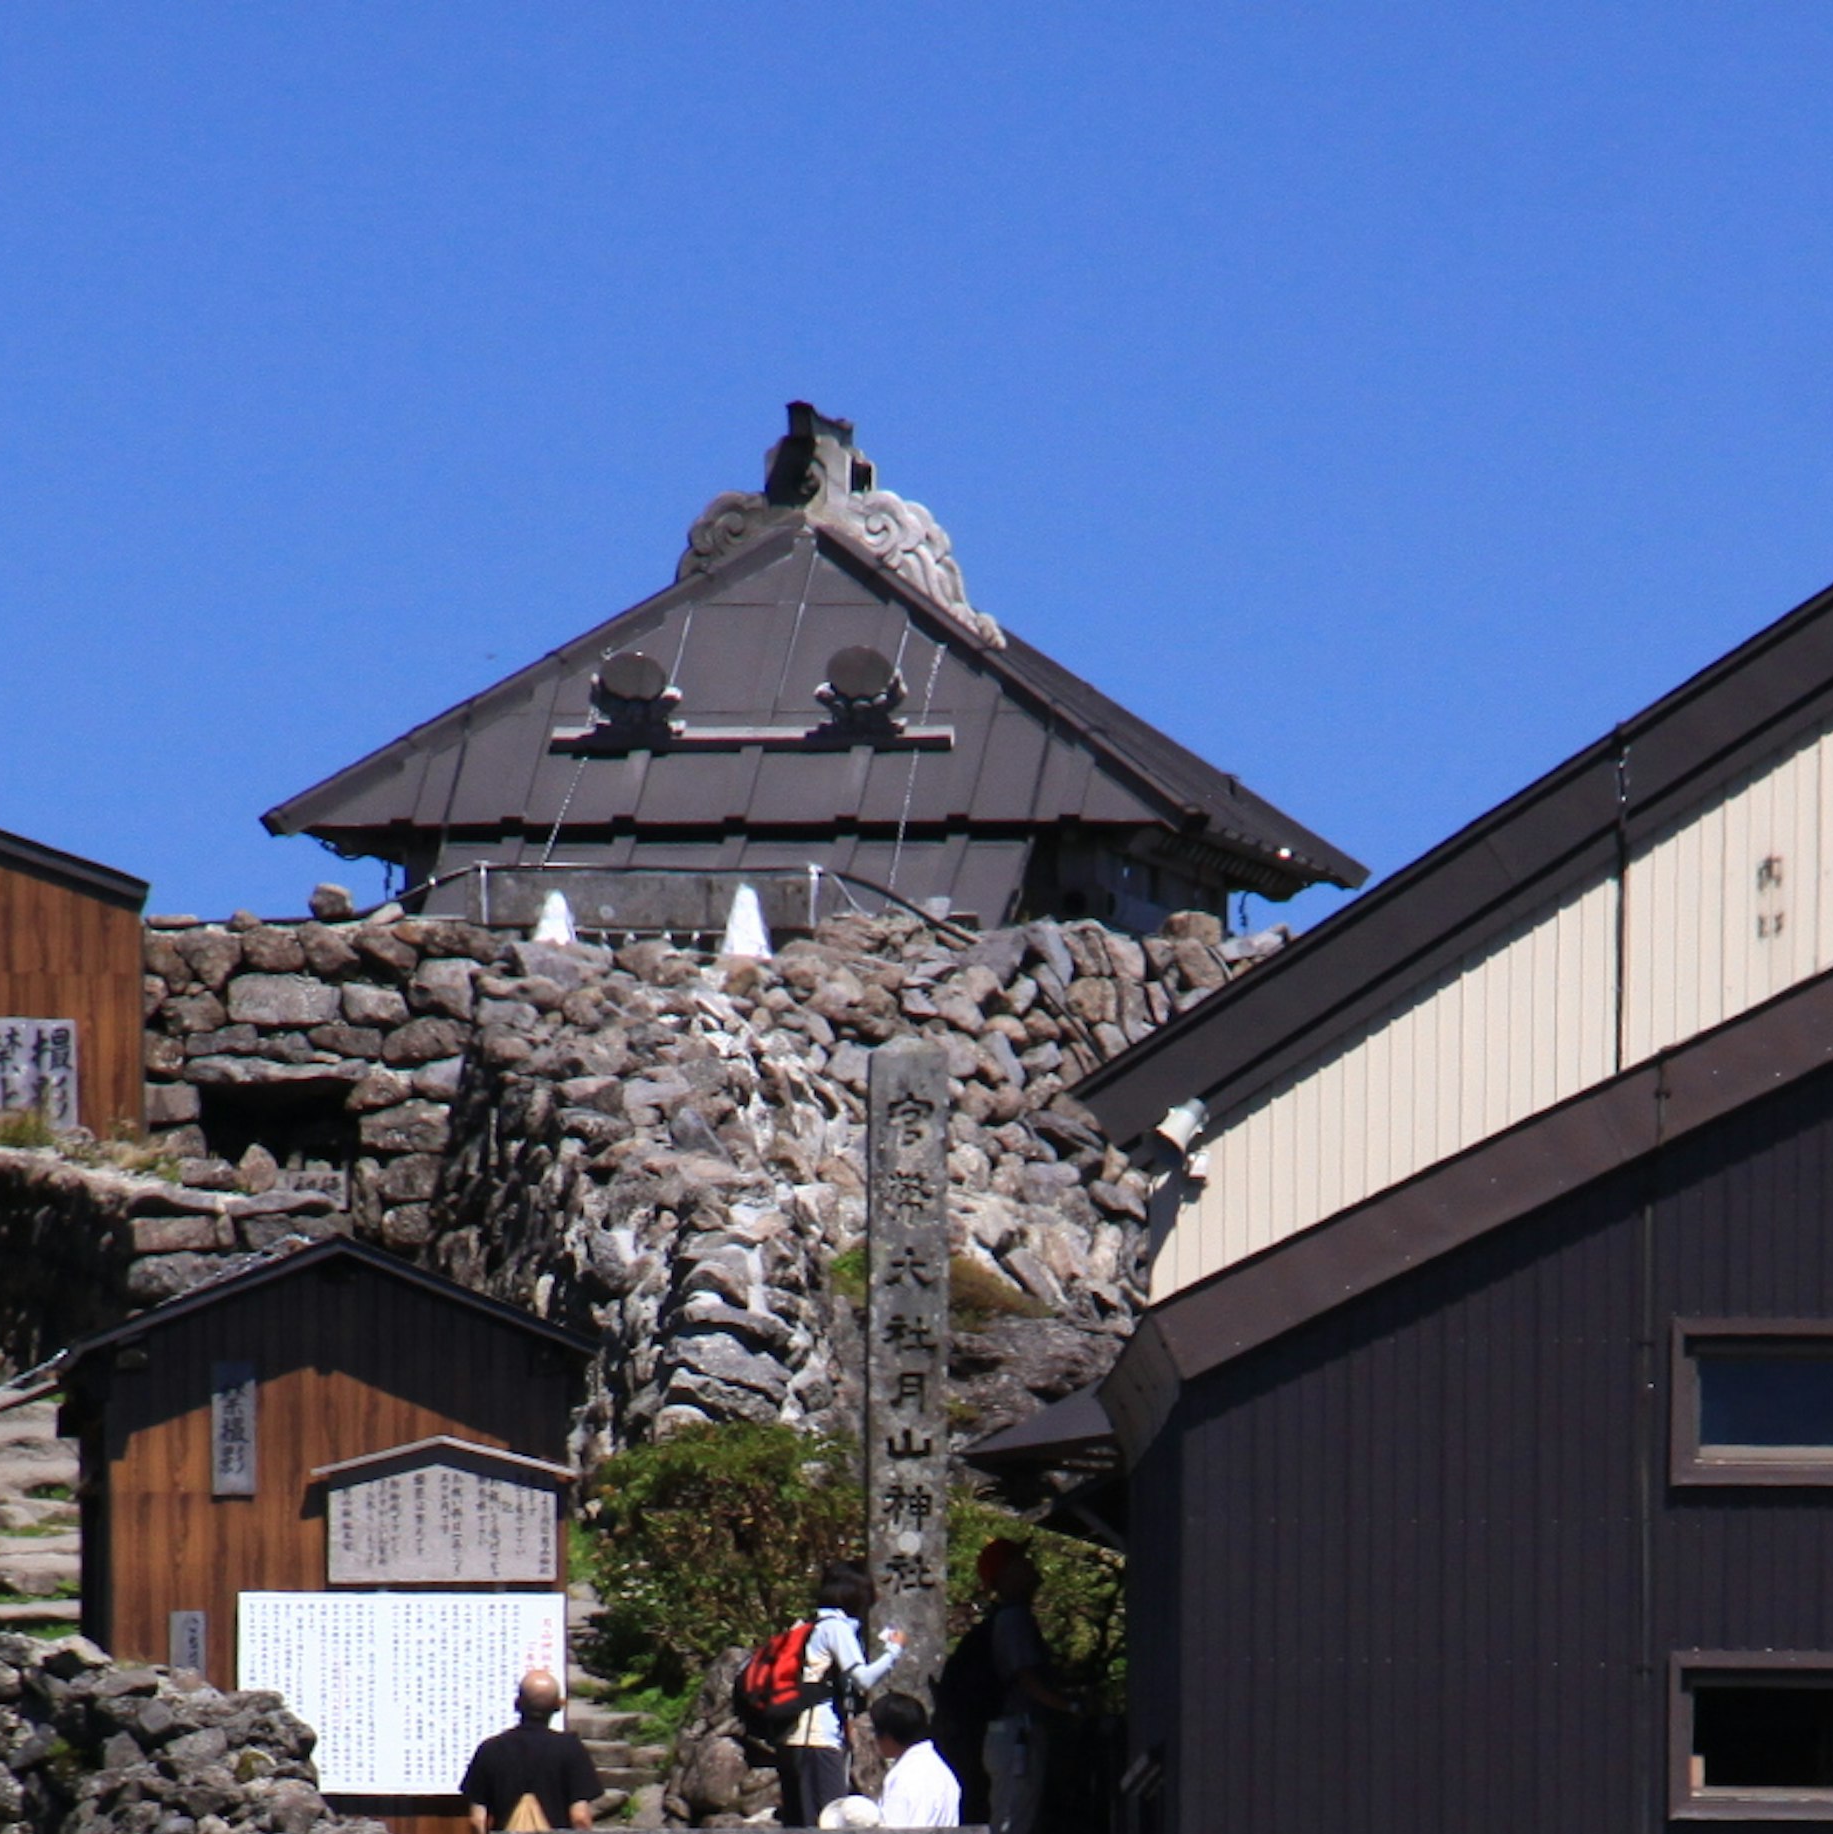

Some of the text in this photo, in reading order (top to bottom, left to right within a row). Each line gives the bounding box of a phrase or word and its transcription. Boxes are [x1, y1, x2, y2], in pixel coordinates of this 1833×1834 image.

[882, 1090, 937, 1594] 官幣大社月山神社
